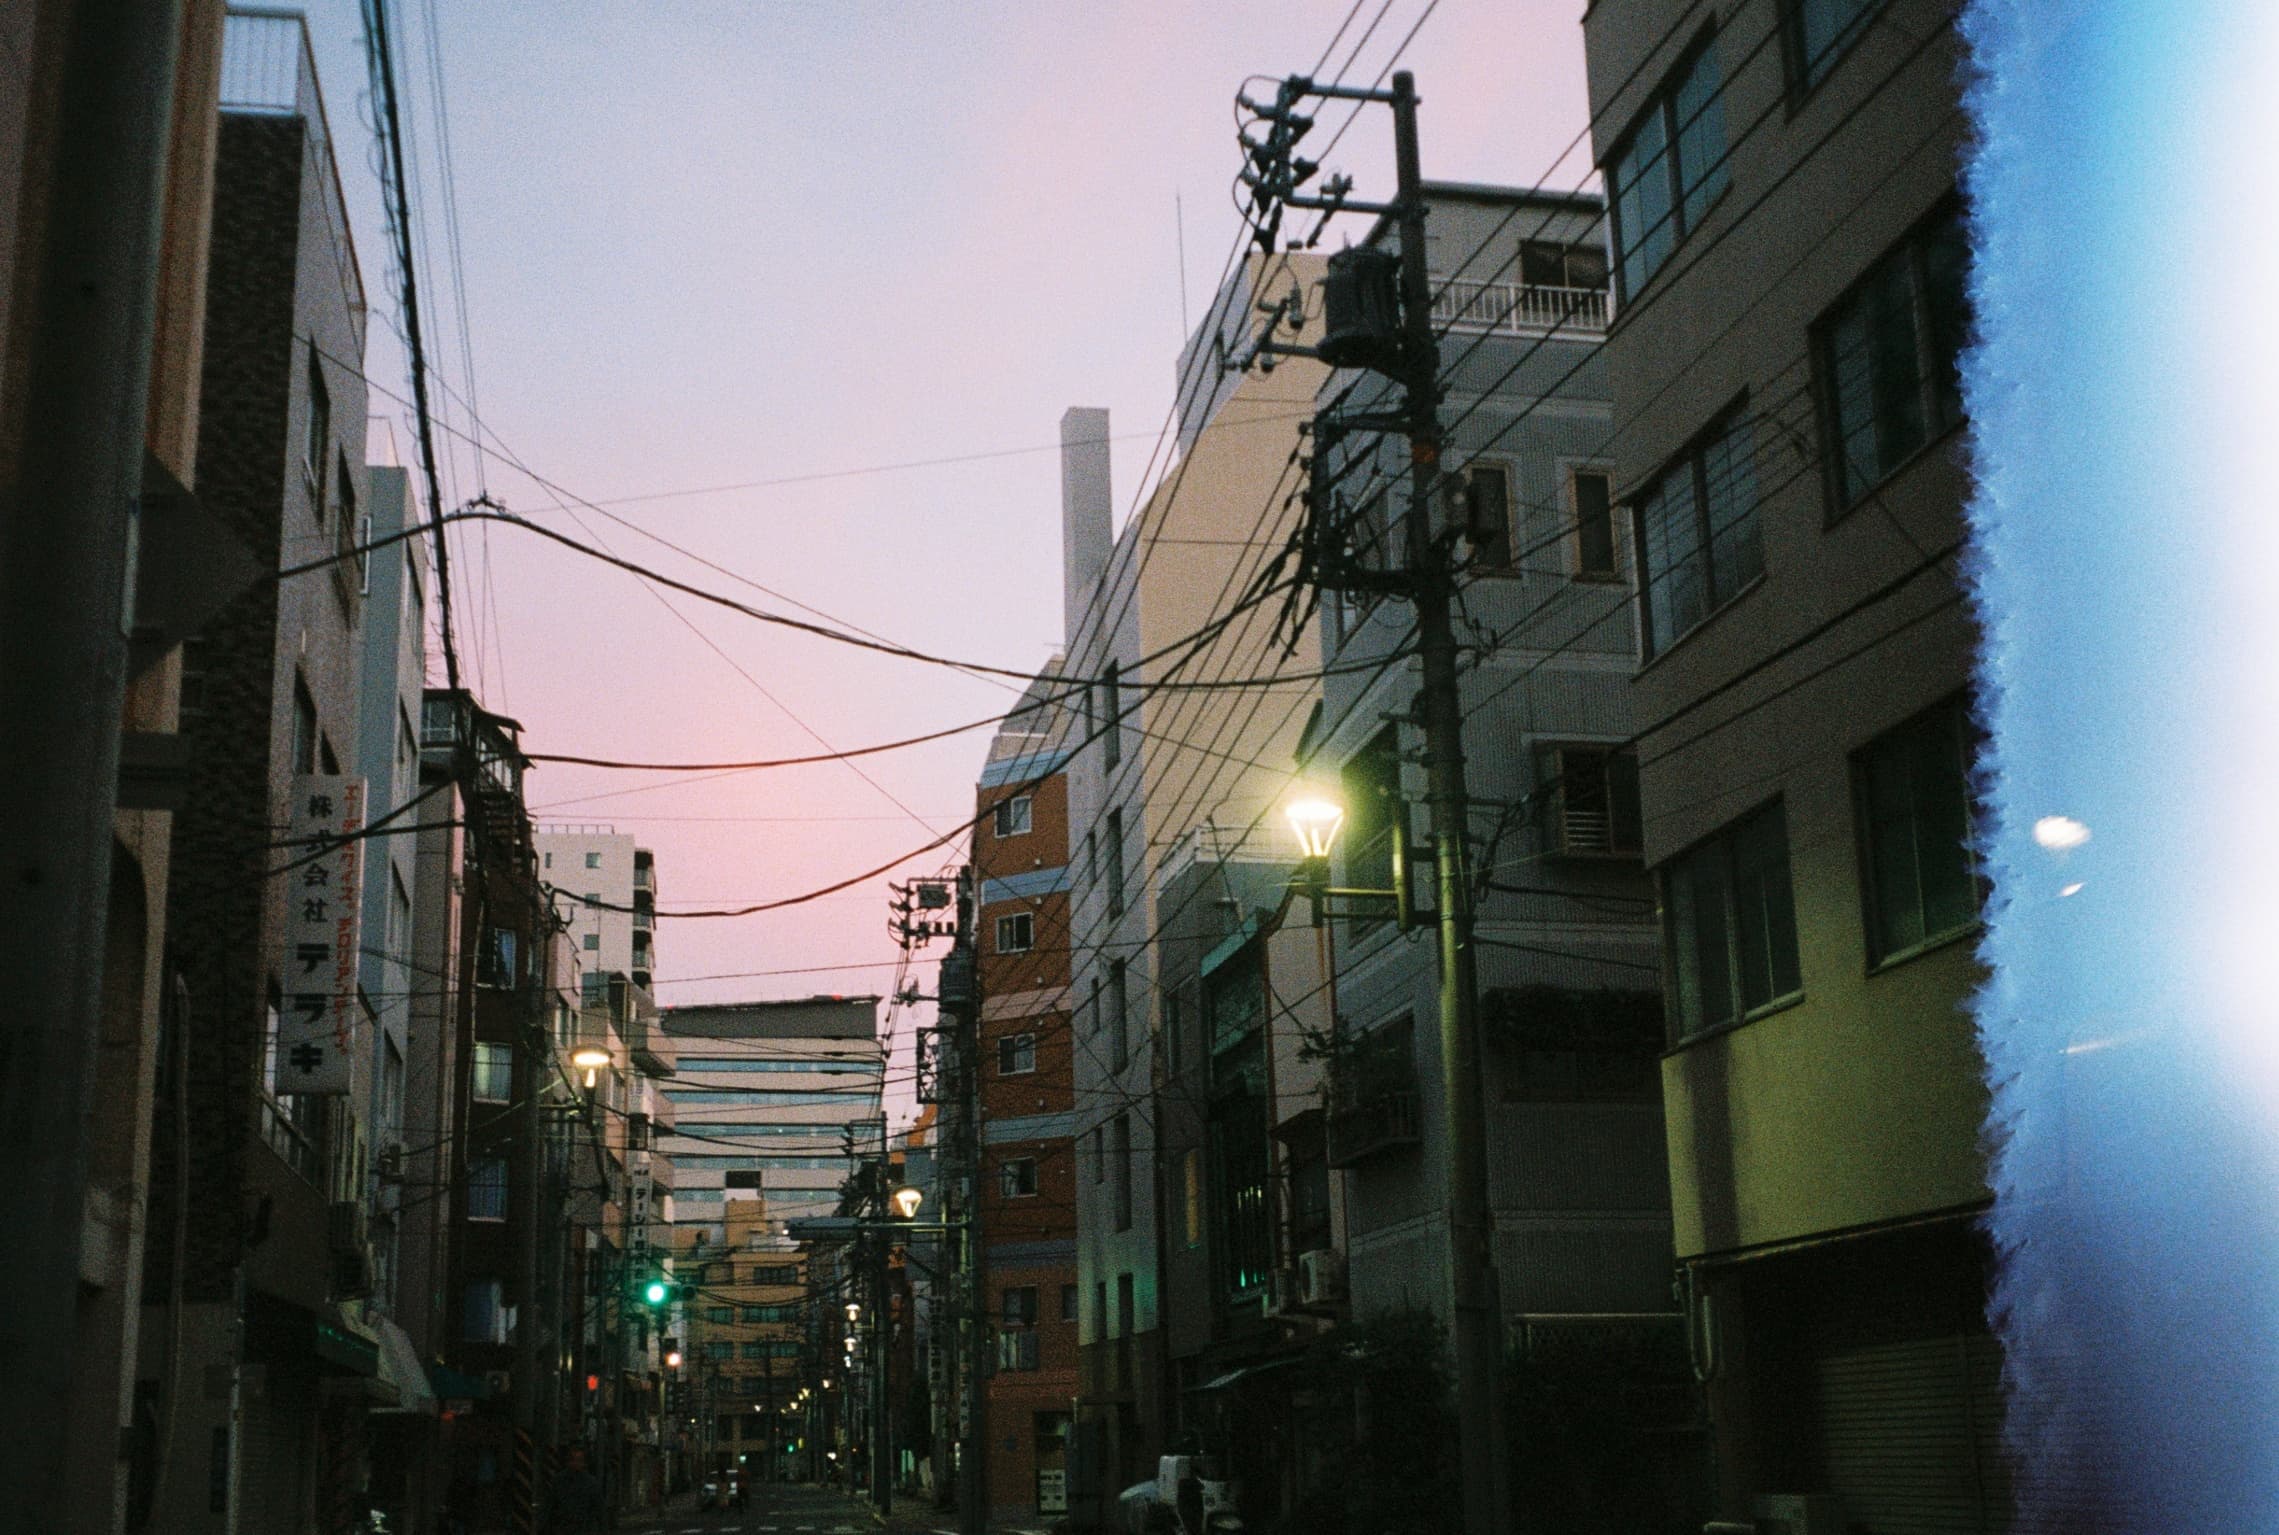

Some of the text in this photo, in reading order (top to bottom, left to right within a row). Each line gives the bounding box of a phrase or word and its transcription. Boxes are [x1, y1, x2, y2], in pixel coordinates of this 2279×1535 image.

[290, 794, 333, 1075] 株式会社テラキ
